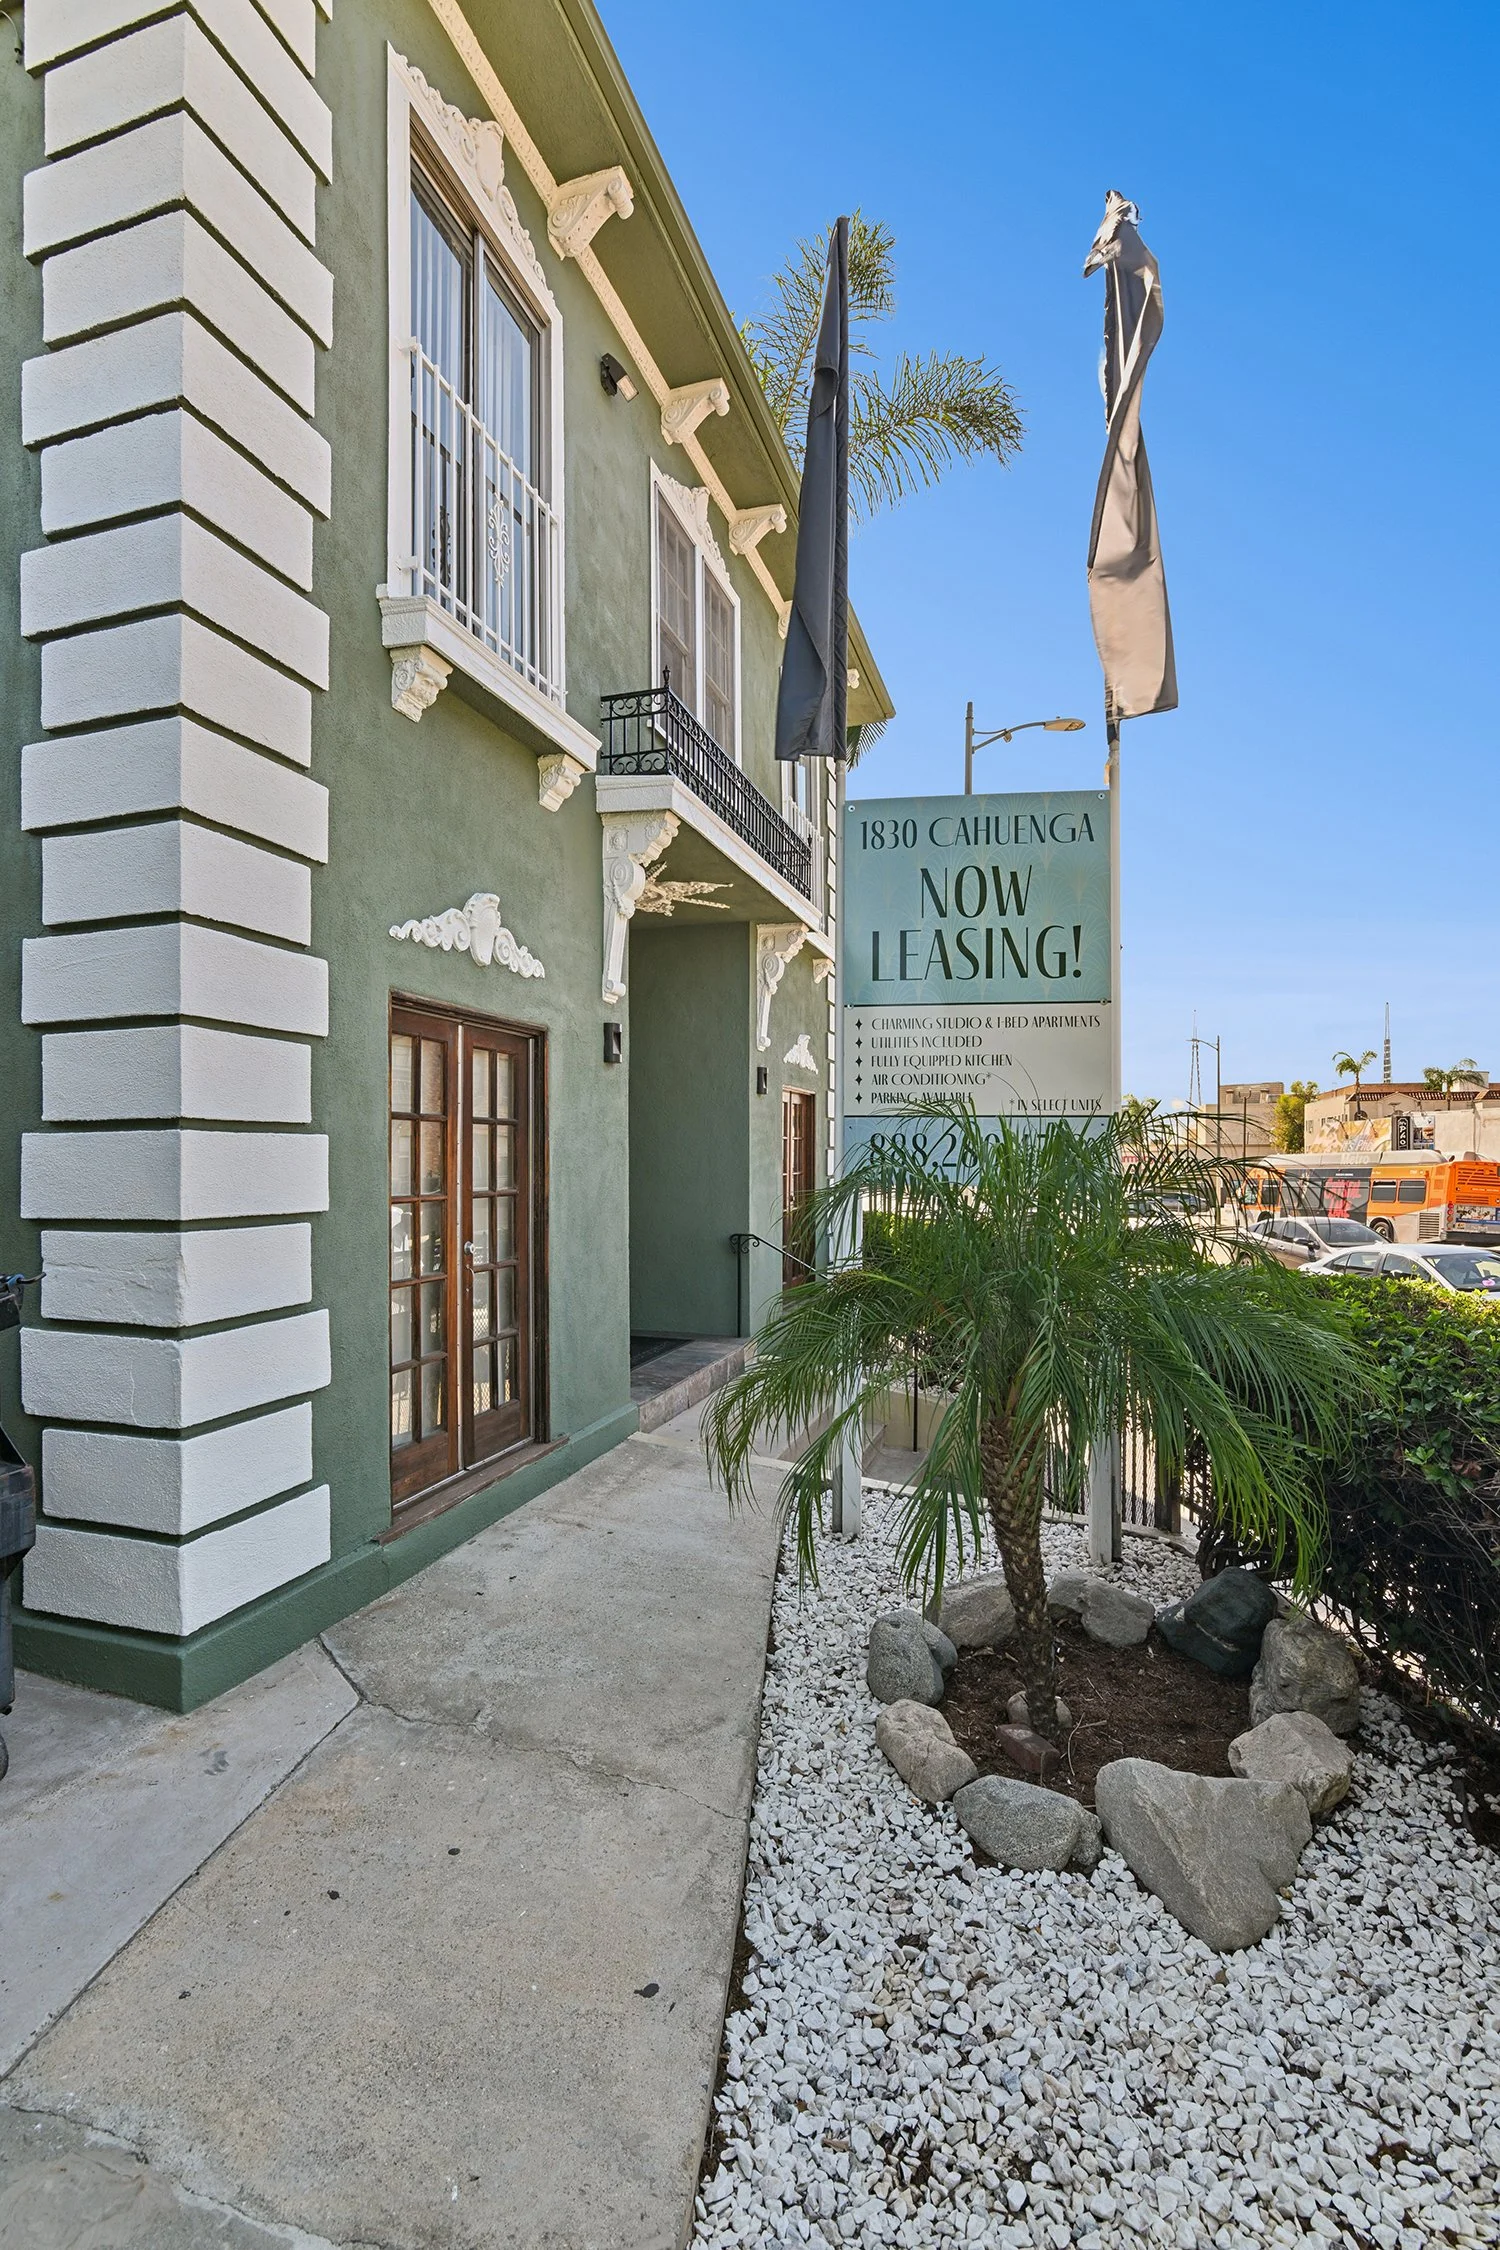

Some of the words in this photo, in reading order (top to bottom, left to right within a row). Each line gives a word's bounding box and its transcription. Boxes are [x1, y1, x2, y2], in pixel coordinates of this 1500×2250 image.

[860, 818, 918, 850] 1830
[928, 812, 1095, 848] CAHUENGA
[920, 864, 1033, 919] NOW
[871, 924, 1082, 982] LEASING!
[871, 1017, 933, 1031] CHARMING
[936, 1016, 982, 1030] STUDIO
[985, 1016, 994, 1029] &
[1031, 1014, 1101, 1028] APARTMENTS
[871, 1036, 919, 1049] UTILITIES
[921, 1035, 983, 1048] INCLUDED
[871, 1055, 900, 1068] FULLY
[903, 1054, 962, 1070] EQUIPPED
[965, 1053, 1013, 1067] KITCHEN
[871, 1073, 888, 1086] AIR
[871, 1091, 918, 1104] PARKING
[921, 1091, 974, 1104] AVAILABLE
[1031, 1098, 1067, 1111] SELECT
[1071, 1097, 1102, 1111] UNITS
